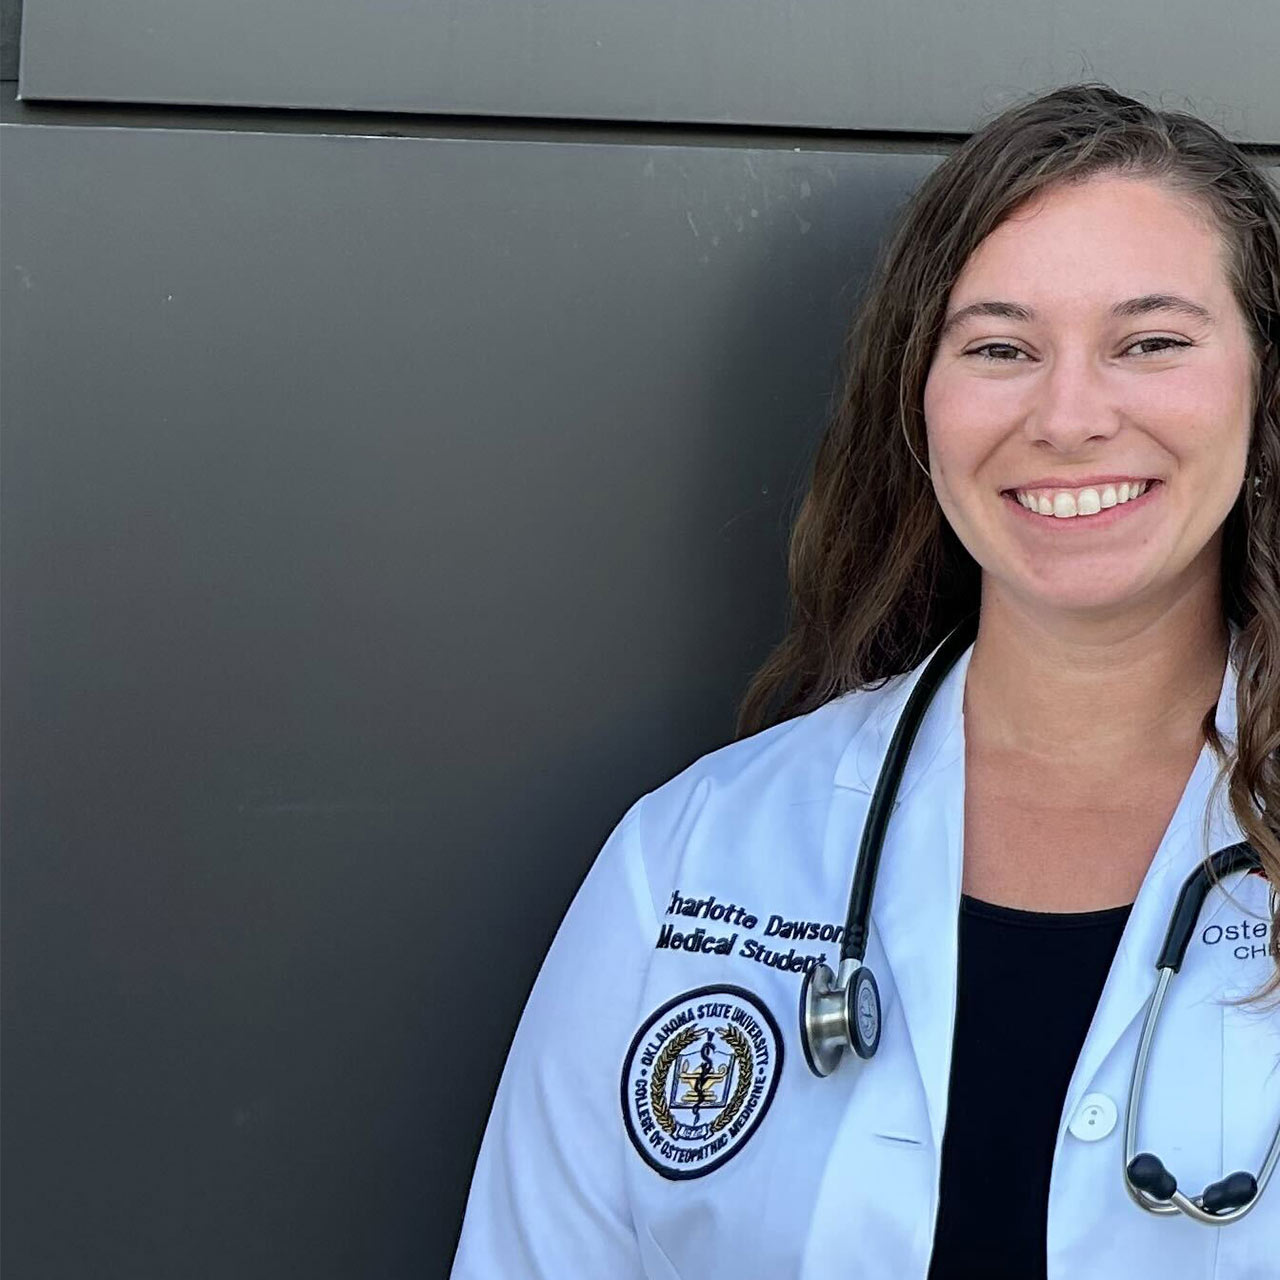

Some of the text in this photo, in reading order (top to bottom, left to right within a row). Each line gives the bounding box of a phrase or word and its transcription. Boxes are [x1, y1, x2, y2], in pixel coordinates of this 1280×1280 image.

[667, 889, 759, 930] harlotte
[1202, 920, 1268, 945] Oste
[640, 1002, 769, 1067] OKLAHOMA STATE UNIVERSITY
[634, 1075, 767, 1163] COLLEGE OF OSTEOPATHIC MEDICINE
